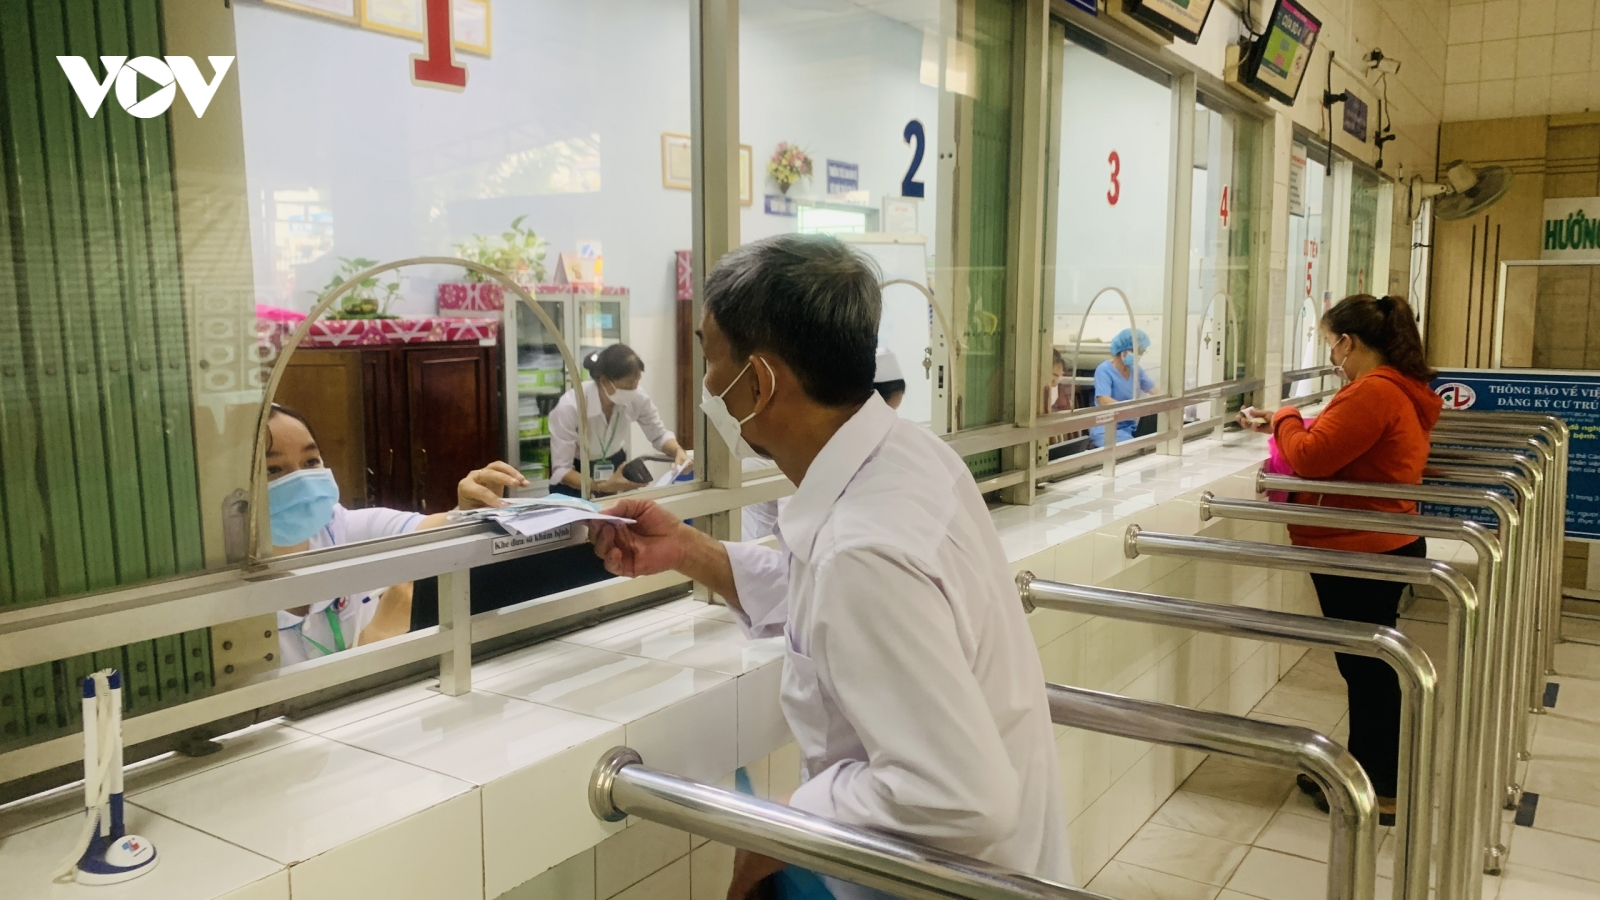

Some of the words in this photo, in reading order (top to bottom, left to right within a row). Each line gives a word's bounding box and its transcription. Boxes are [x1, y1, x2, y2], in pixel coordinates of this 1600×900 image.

[414, 0, 466, 88] 1
[901, 119, 925, 198] 2
[1106, 150, 1120, 206] 3
[1219, 185, 1229, 227] 4
[1305, 261, 1313, 296] 5
[1488, 383, 1531, 395] THÔNG
[1533, 385, 1560, 396] BÁO
[1497, 396, 1531, 407] ĐĂNG
[1534, 397, 1551, 408] KÝ
[1553, 399, 1572, 409] CƯ
[1573, 399, 1600, 410] TRÚ
[494, 541, 509, 550] Khe
